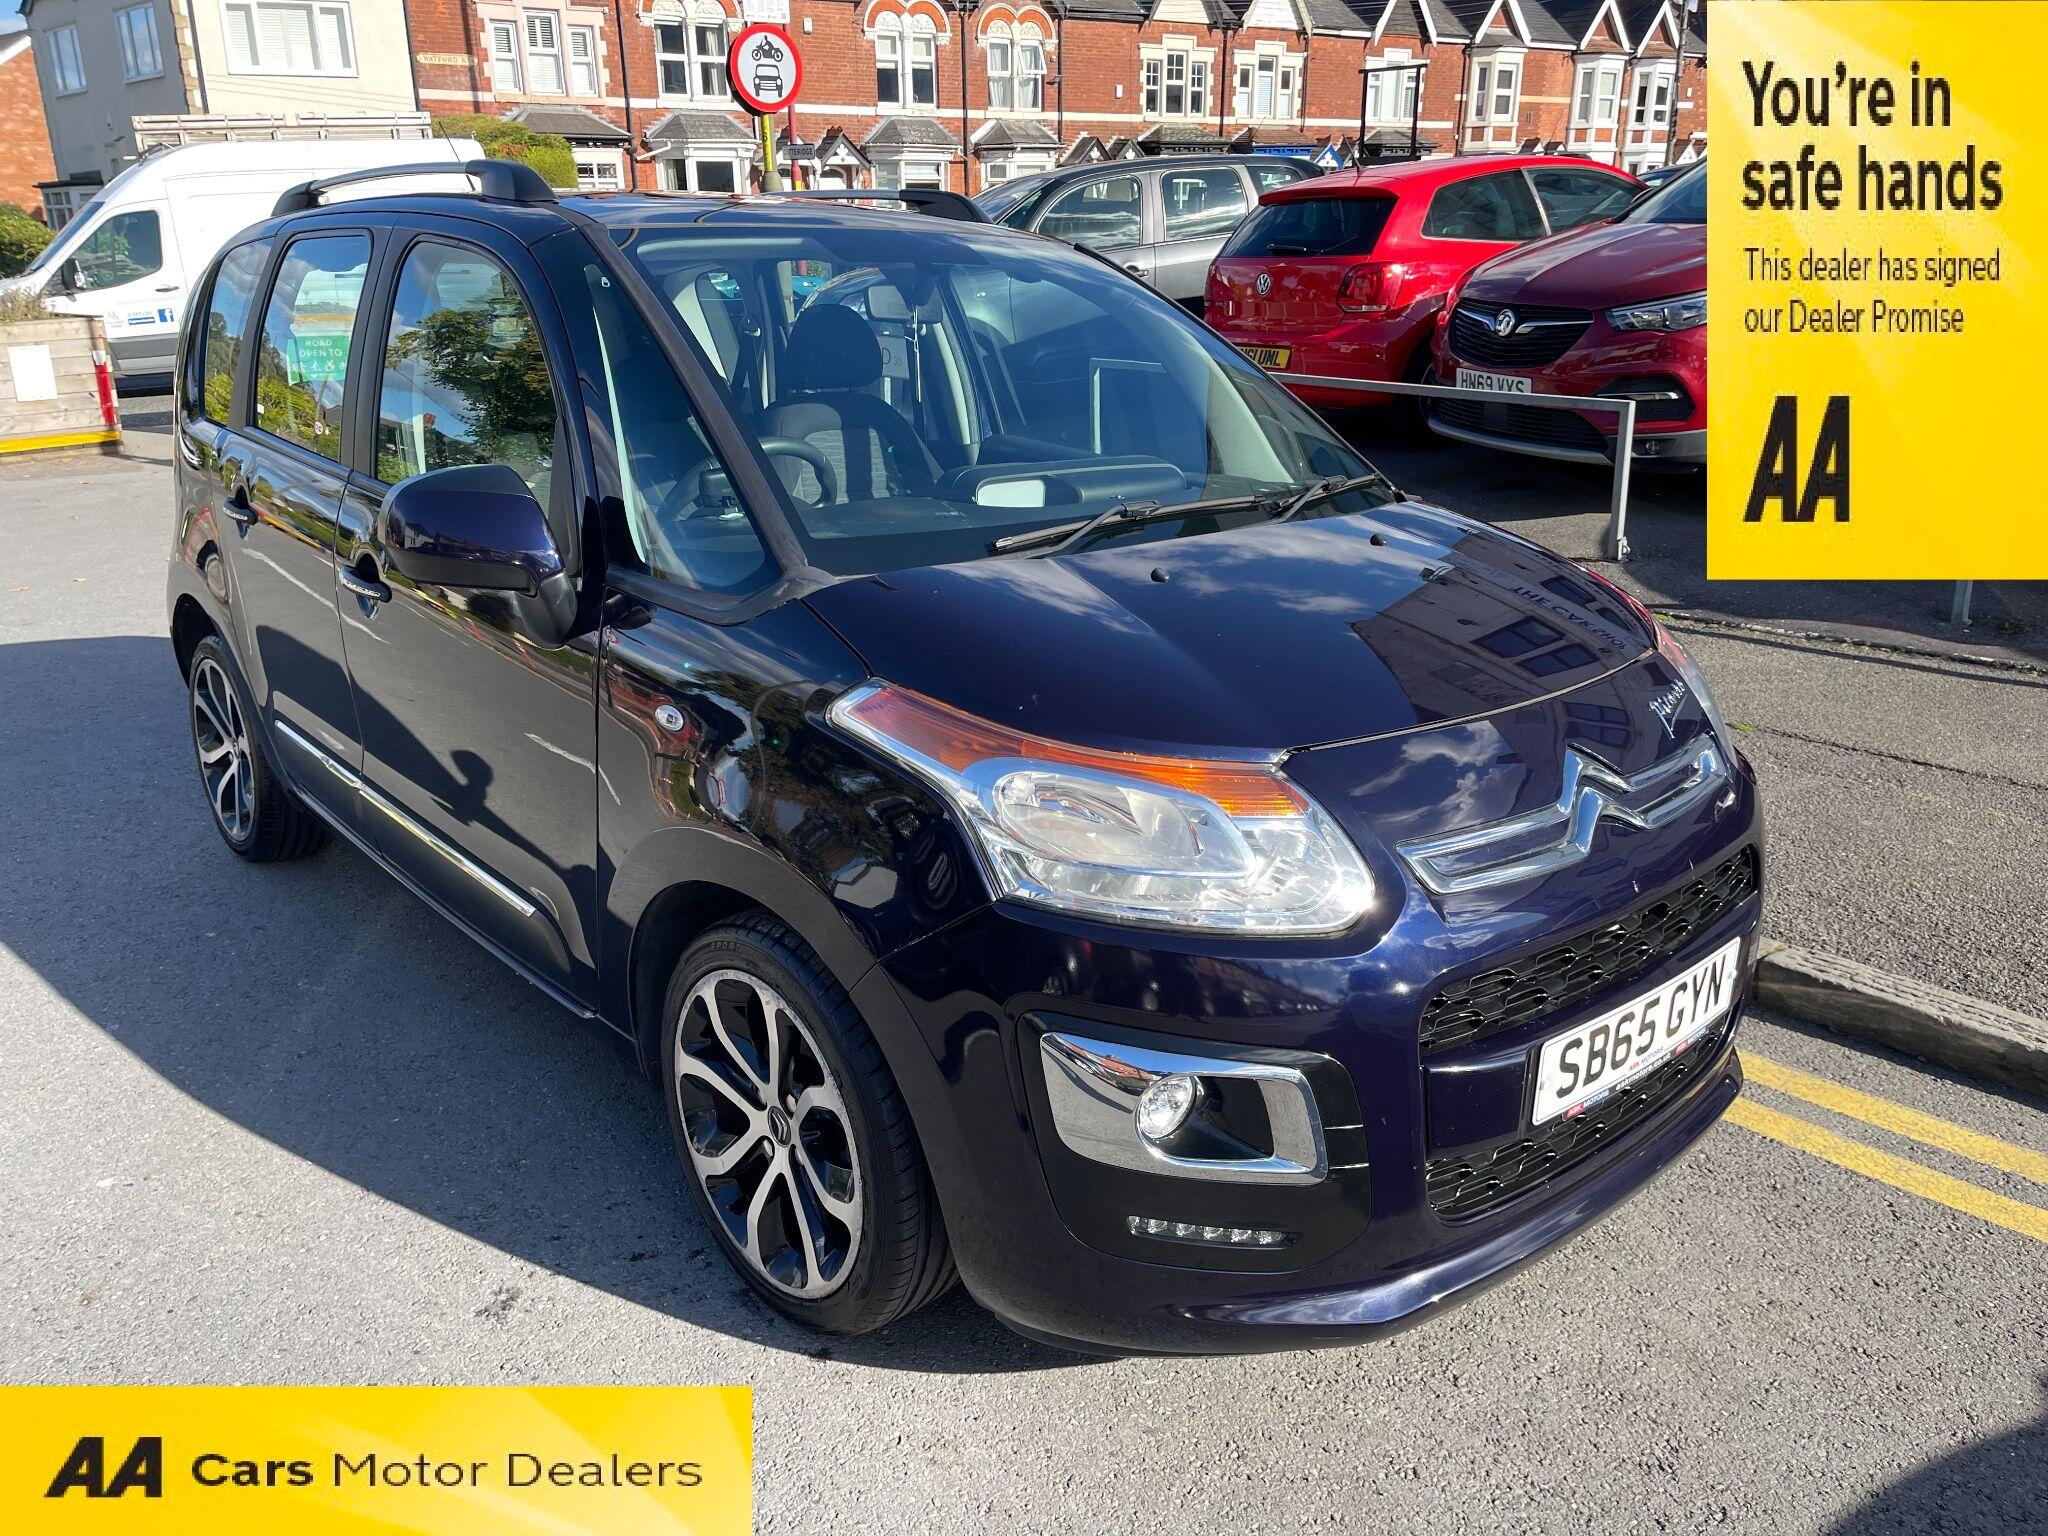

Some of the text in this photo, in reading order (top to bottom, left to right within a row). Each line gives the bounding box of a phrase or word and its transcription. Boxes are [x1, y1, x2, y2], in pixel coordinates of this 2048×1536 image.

[305, 339, 332, 347] ROAD
[299, 348, 342, 357] OPEN TO
[1258, 350, 1281, 367] UML
[1461, 371, 1493, 391] HN69
[1556, 953, 1727, 1100] SB65 GYN
[1566, 1101, 1584, 1118] ASK
[1584, 1089, 1610, 1108] MOTORS
